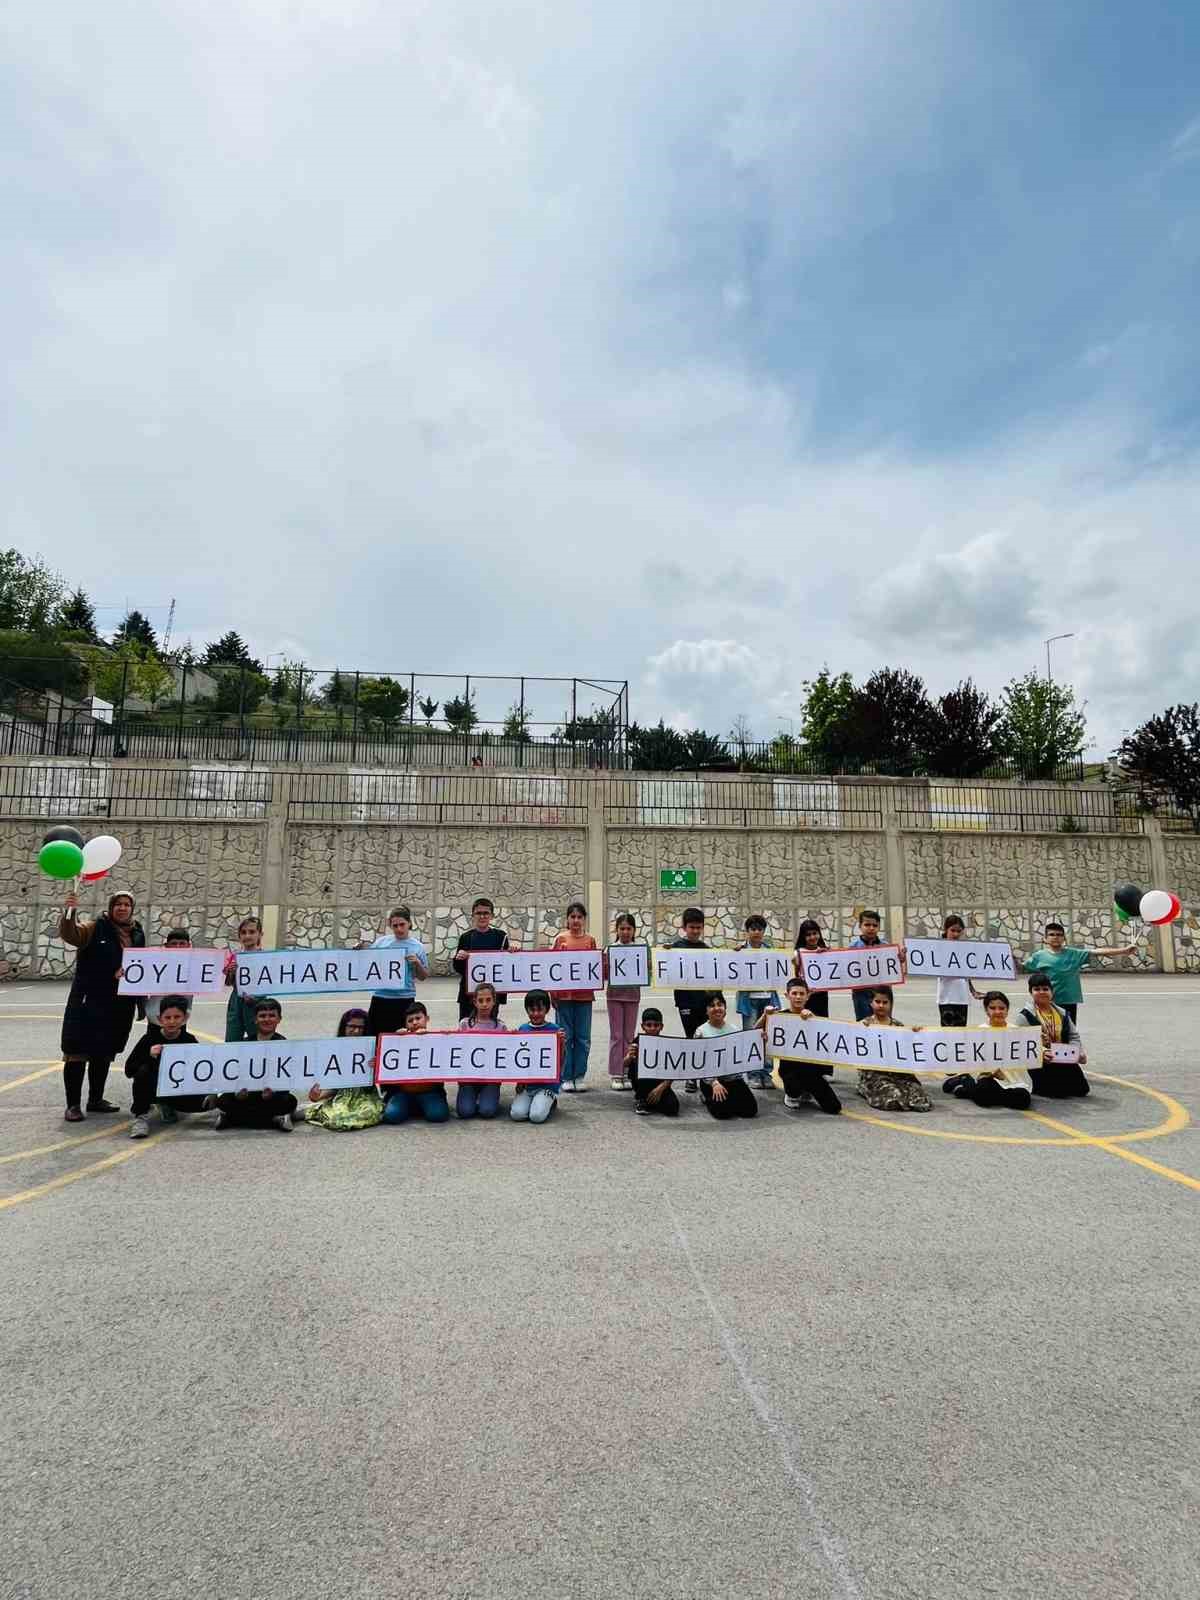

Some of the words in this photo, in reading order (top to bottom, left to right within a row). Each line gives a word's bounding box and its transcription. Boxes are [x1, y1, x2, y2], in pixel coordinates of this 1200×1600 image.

[123, 959, 215, 984] ÖYLE
[614, 954, 640, 977] Kİ
[657, 957, 789, 980] FİLİSTİN
[807, 956, 899, 982] ÖZGÜR
[910, 950, 1012, 971] OLACAK
[240, 961, 402, 987] BAHARLAR
[470, 963, 600, 985] GELECEK
[382, 1041, 552, 1071] GELECEĞE
[643, 1041, 762, 1072] UMUTLA
[772, 1027, 1038, 1063] BAKABİLECEKLER
[169, 1053, 367, 1088] ÇOCUKLAR
